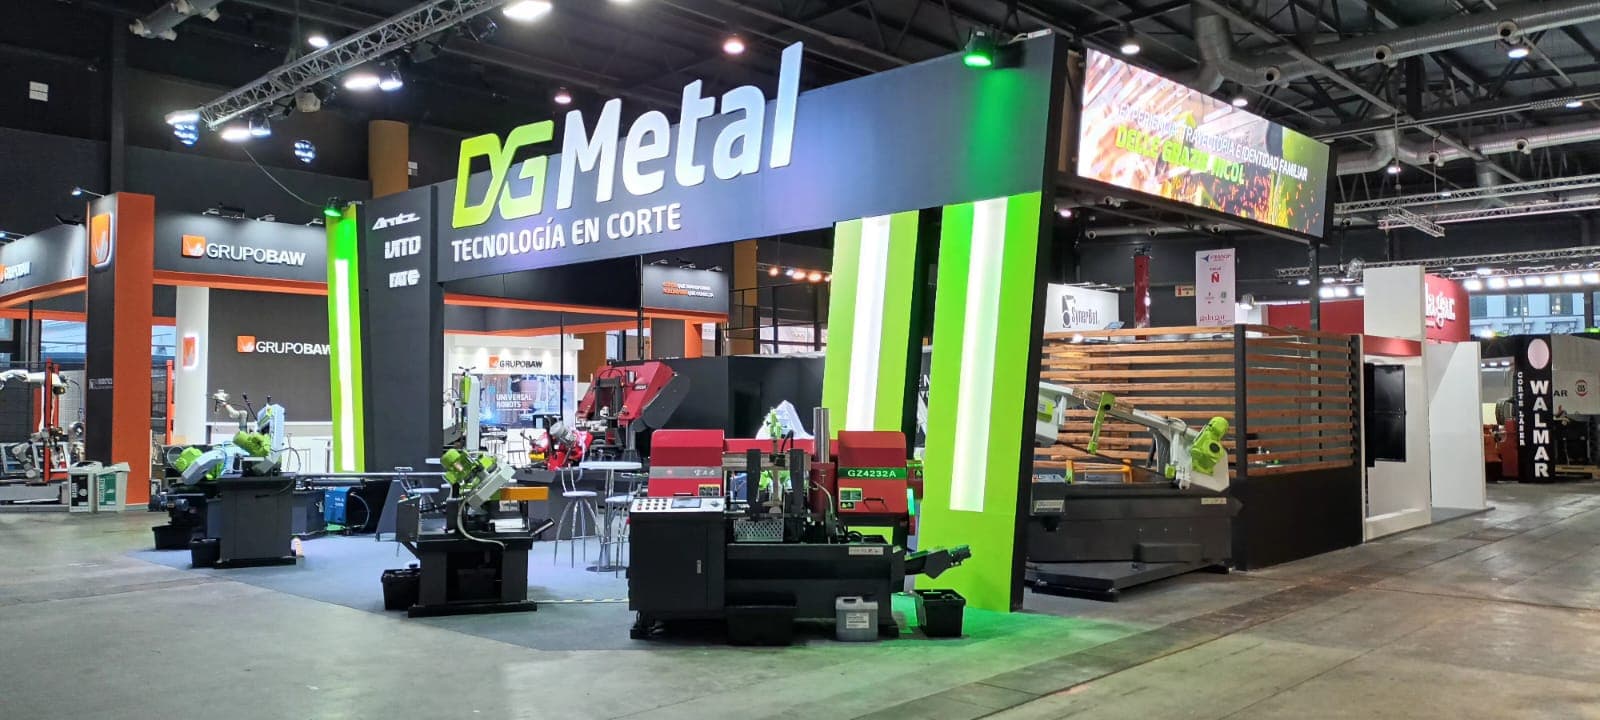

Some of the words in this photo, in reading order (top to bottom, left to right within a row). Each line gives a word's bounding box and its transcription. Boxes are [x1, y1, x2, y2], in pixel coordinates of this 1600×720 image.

[556, 41, 803, 210] Metal
[1116, 124, 1160, 159] DELLE
[1236, 144, 1241, 158] E
[1241, 147, 1278, 172] IDENTIDAD
[1278, 159, 1308, 182] FAMILIAR
[452, 217, 566, 262] TECNOLOGÍA
[572, 217, 600, 245] EN
[606, 202, 681, 240] CORTE
[206, 243, 306, 266] GRUPOBAW
[500, 360, 542, 368] GRUPOBAW
[1530, 380, 1550, 478] WALMAR
